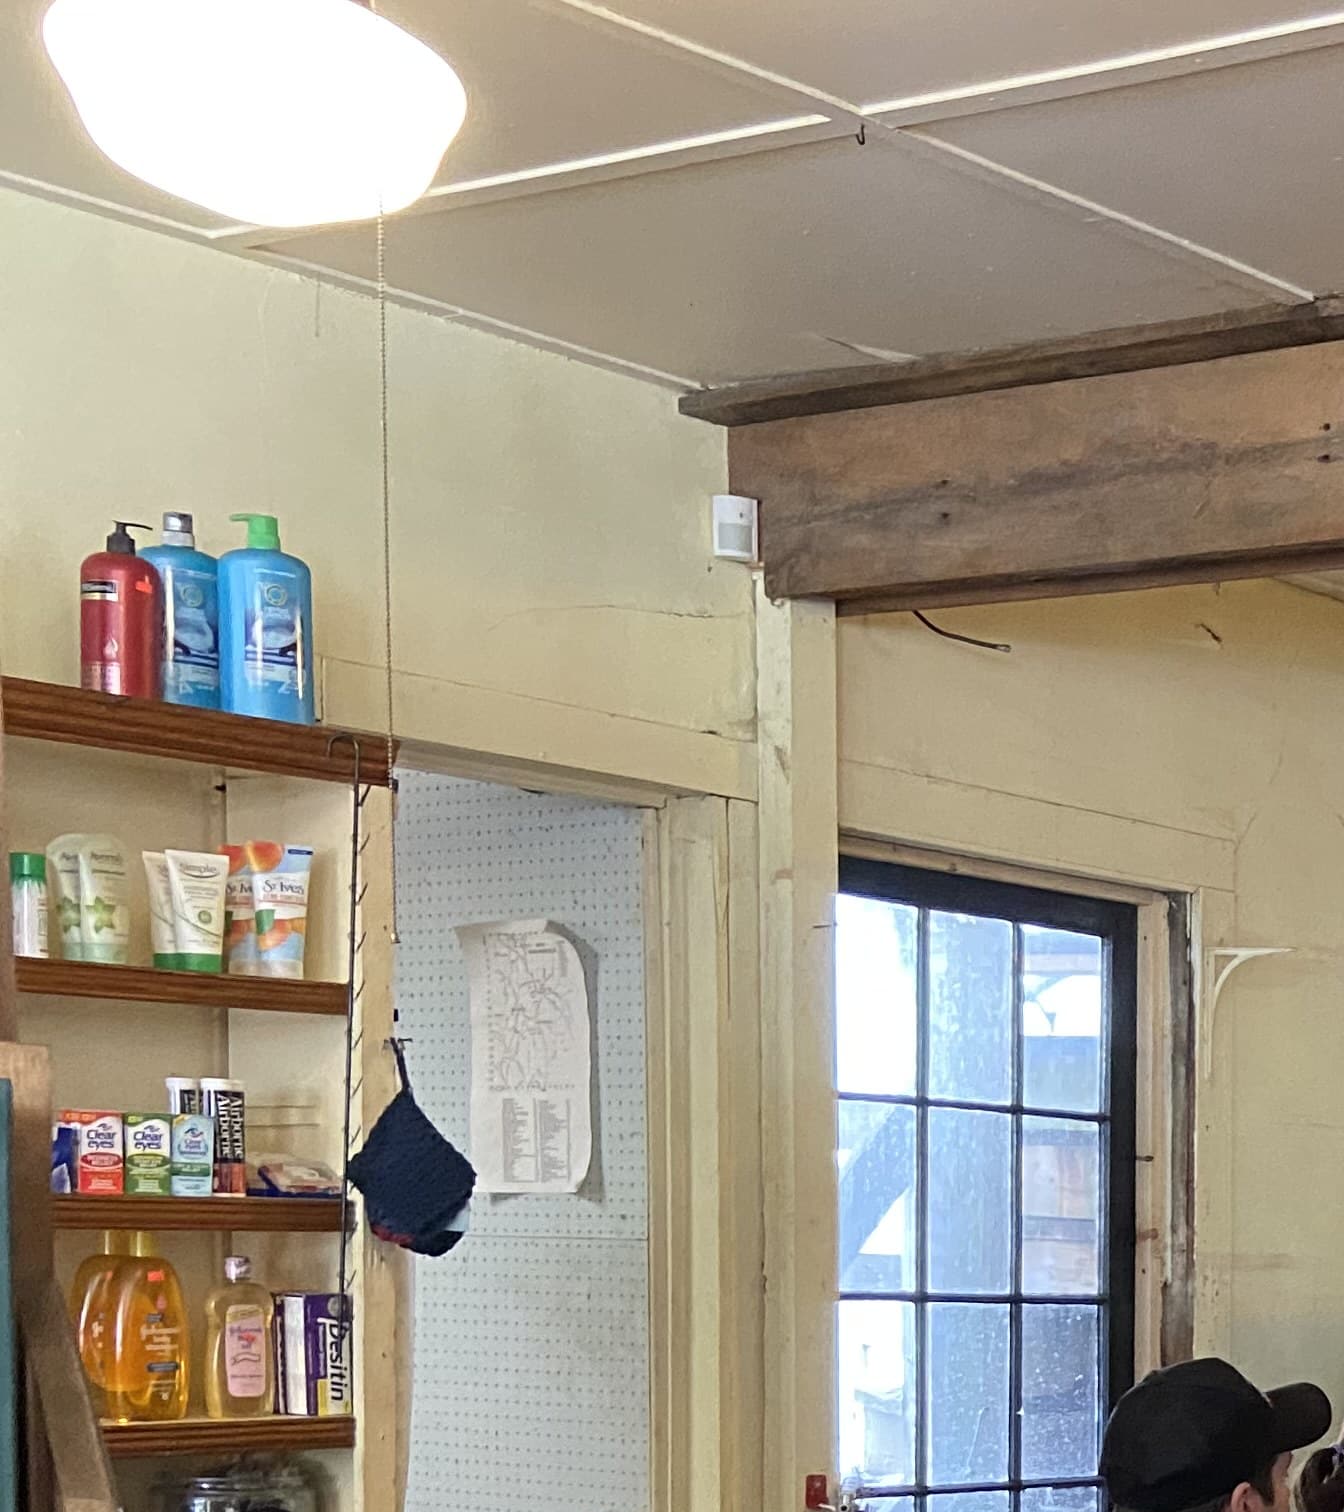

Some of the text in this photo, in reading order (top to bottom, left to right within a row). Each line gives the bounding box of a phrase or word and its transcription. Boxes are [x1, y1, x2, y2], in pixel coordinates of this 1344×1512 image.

[216, 1093, 231, 1159] Airborne
[86, 1129, 117, 1141] Clear
[133, 1130, 164, 1142] Clear
[87, 1140, 115, 1151] eyes
[134, 1141, 162, 1152] eyes
